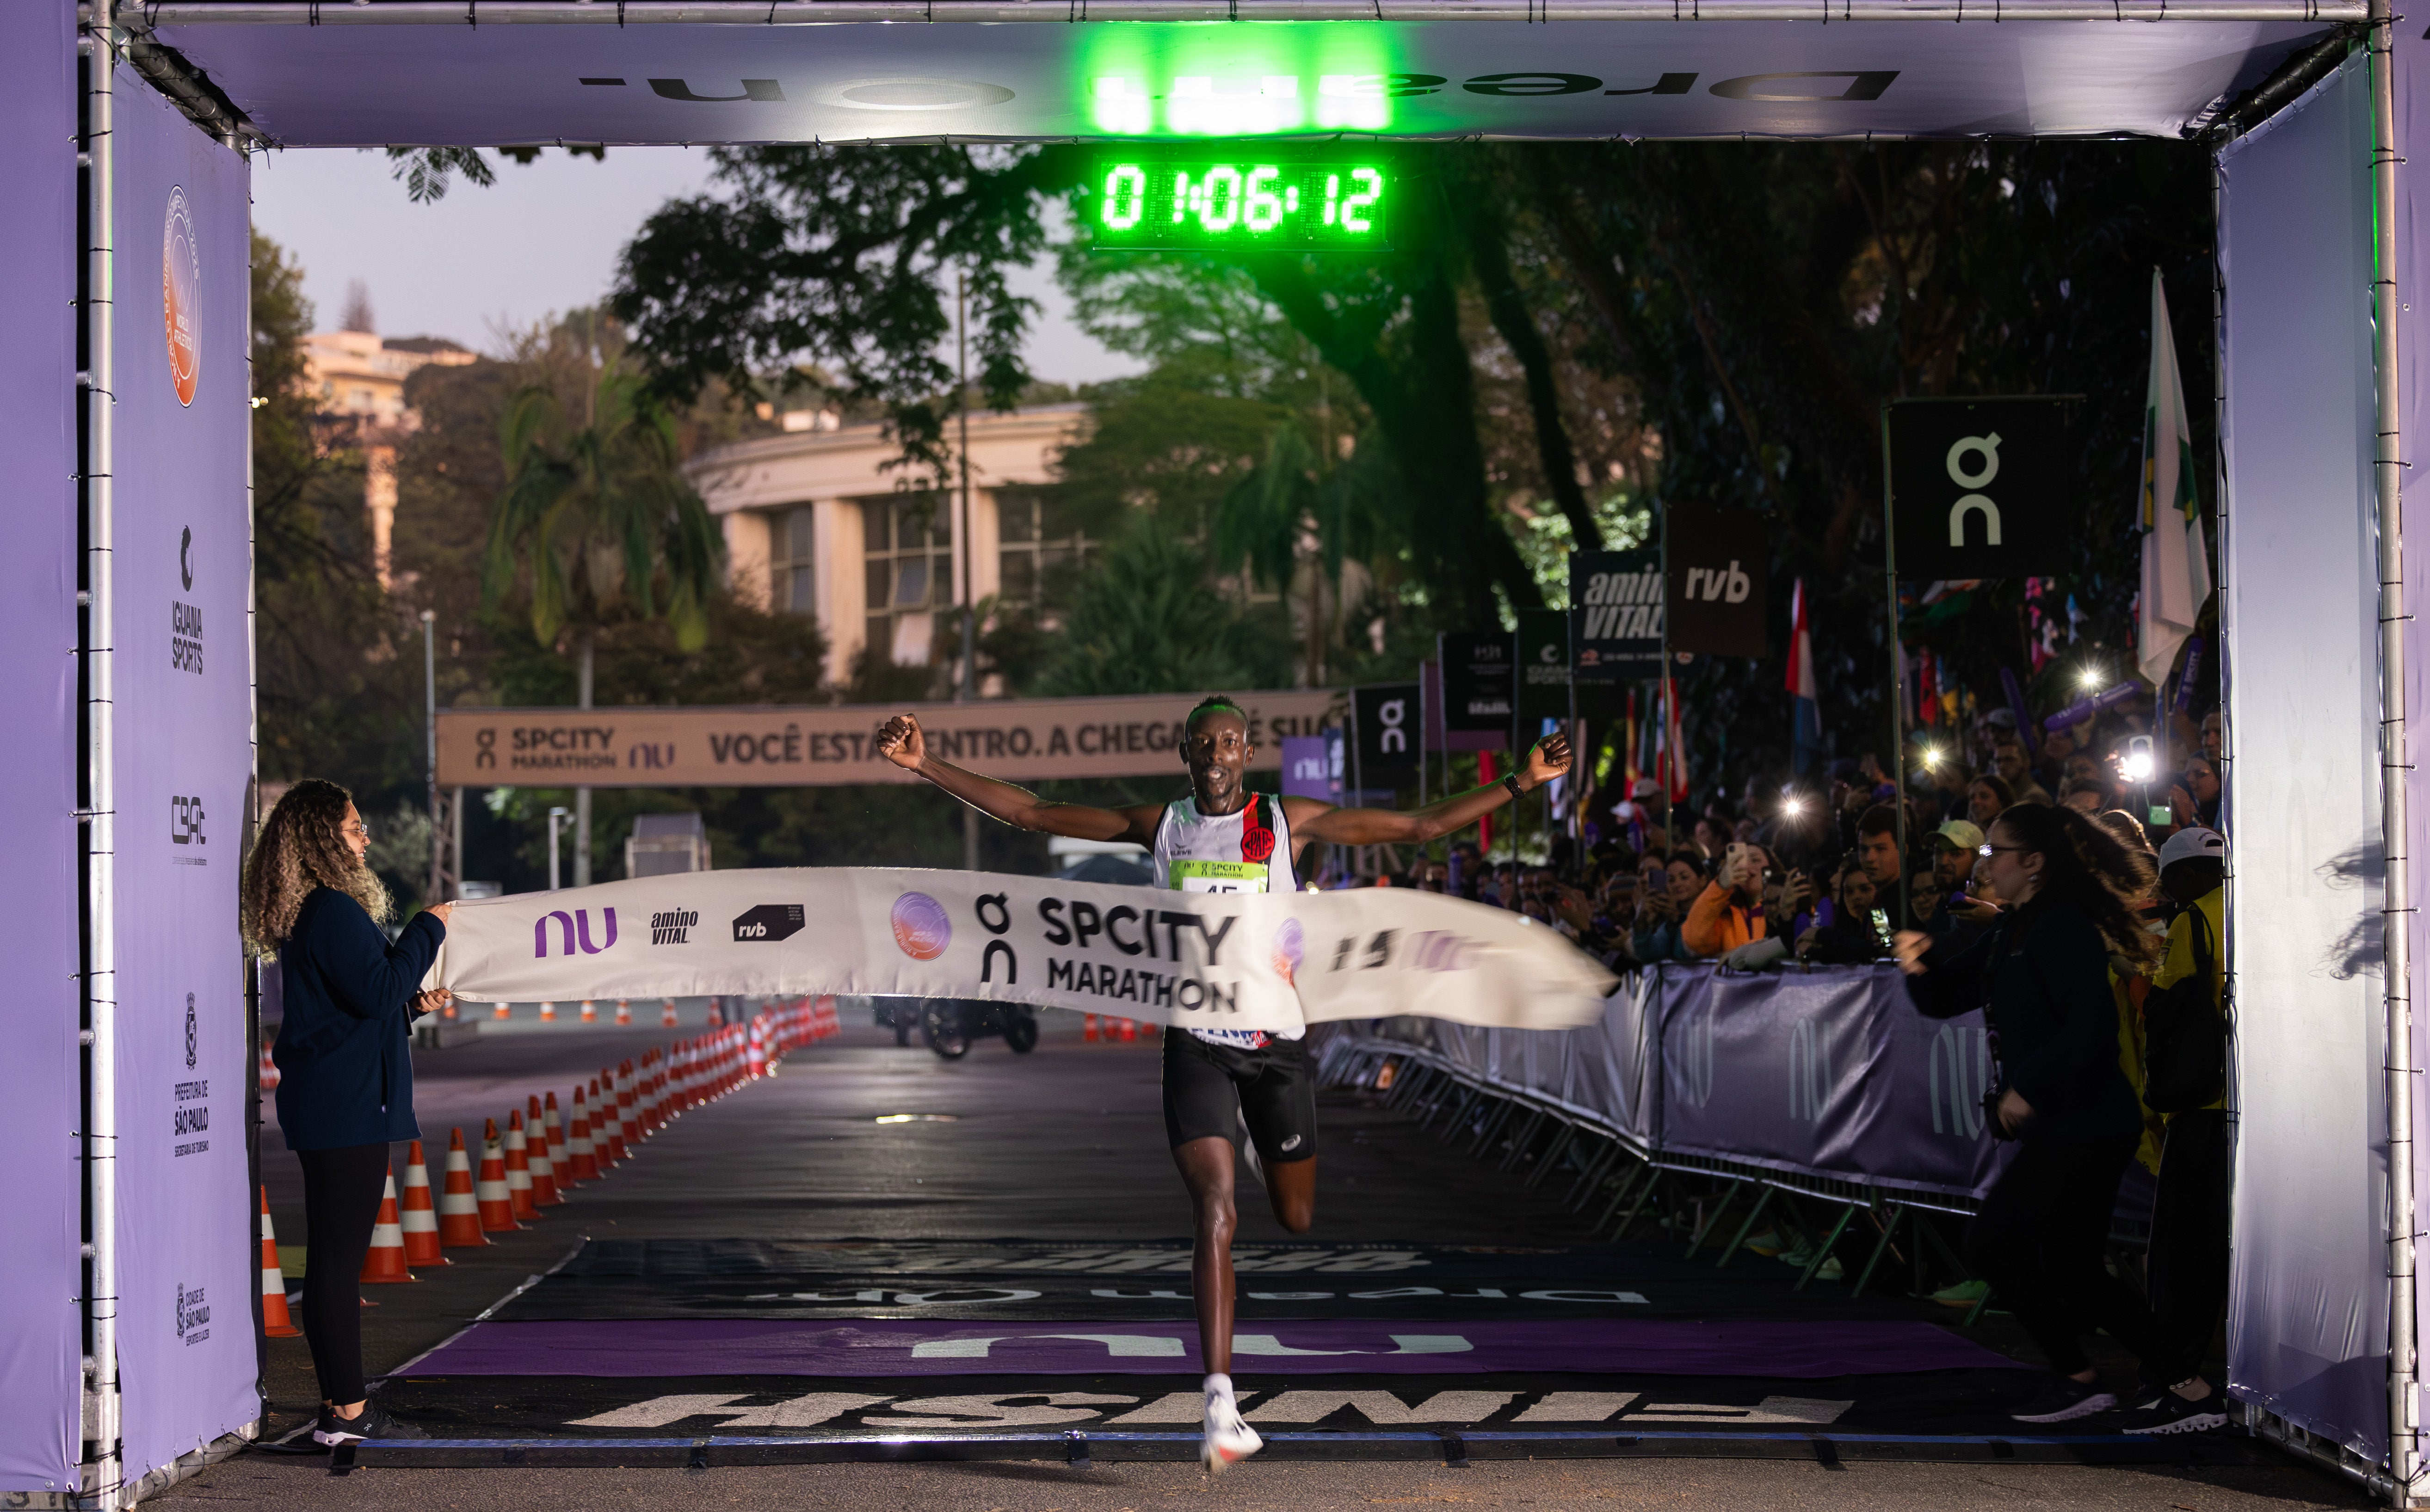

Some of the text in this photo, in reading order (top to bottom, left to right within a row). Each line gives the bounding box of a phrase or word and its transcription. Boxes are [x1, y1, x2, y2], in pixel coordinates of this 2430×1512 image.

[1100, 166, 1384, 231] 01:06:12
[176, 312, 189, 333] WORLD
[173, 328, 192, 352] ATHLETICS
[1685, 559, 1751, 604] rvb
[172, 600, 203, 640] IGUANA
[1583, 605, 1664, 639] VITAL
[172, 636, 203, 676] SPORTS
[512, 726, 615, 752] SPCITY
[708, 725, 802, 765] VOCÊ
[924, 724, 1042, 760] ENTRO.
[1048, 726, 1072, 757] A
[1075, 720, 1187, 754] CHEGA
[512, 752, 617, 771] MARATHON
[1211, 863, 1244, 872] SPCITY
[651, 907, 698, 928] amino
[739, 922, 767, 938] rvb
[1038, 896, 1239, 967] SPCITY
[1047, 957, 1238, 1014] MARATHON
[174, 1079, 208, 1102] PREFEITURA DE
[174, 1105, 208, 1137] SÃO PAULO
[199, 1287, 204, 1303] DE
[186, 1305, 210, 1330] SÃO PAULO
[561, 1390, 1856, 1427] FINISH
